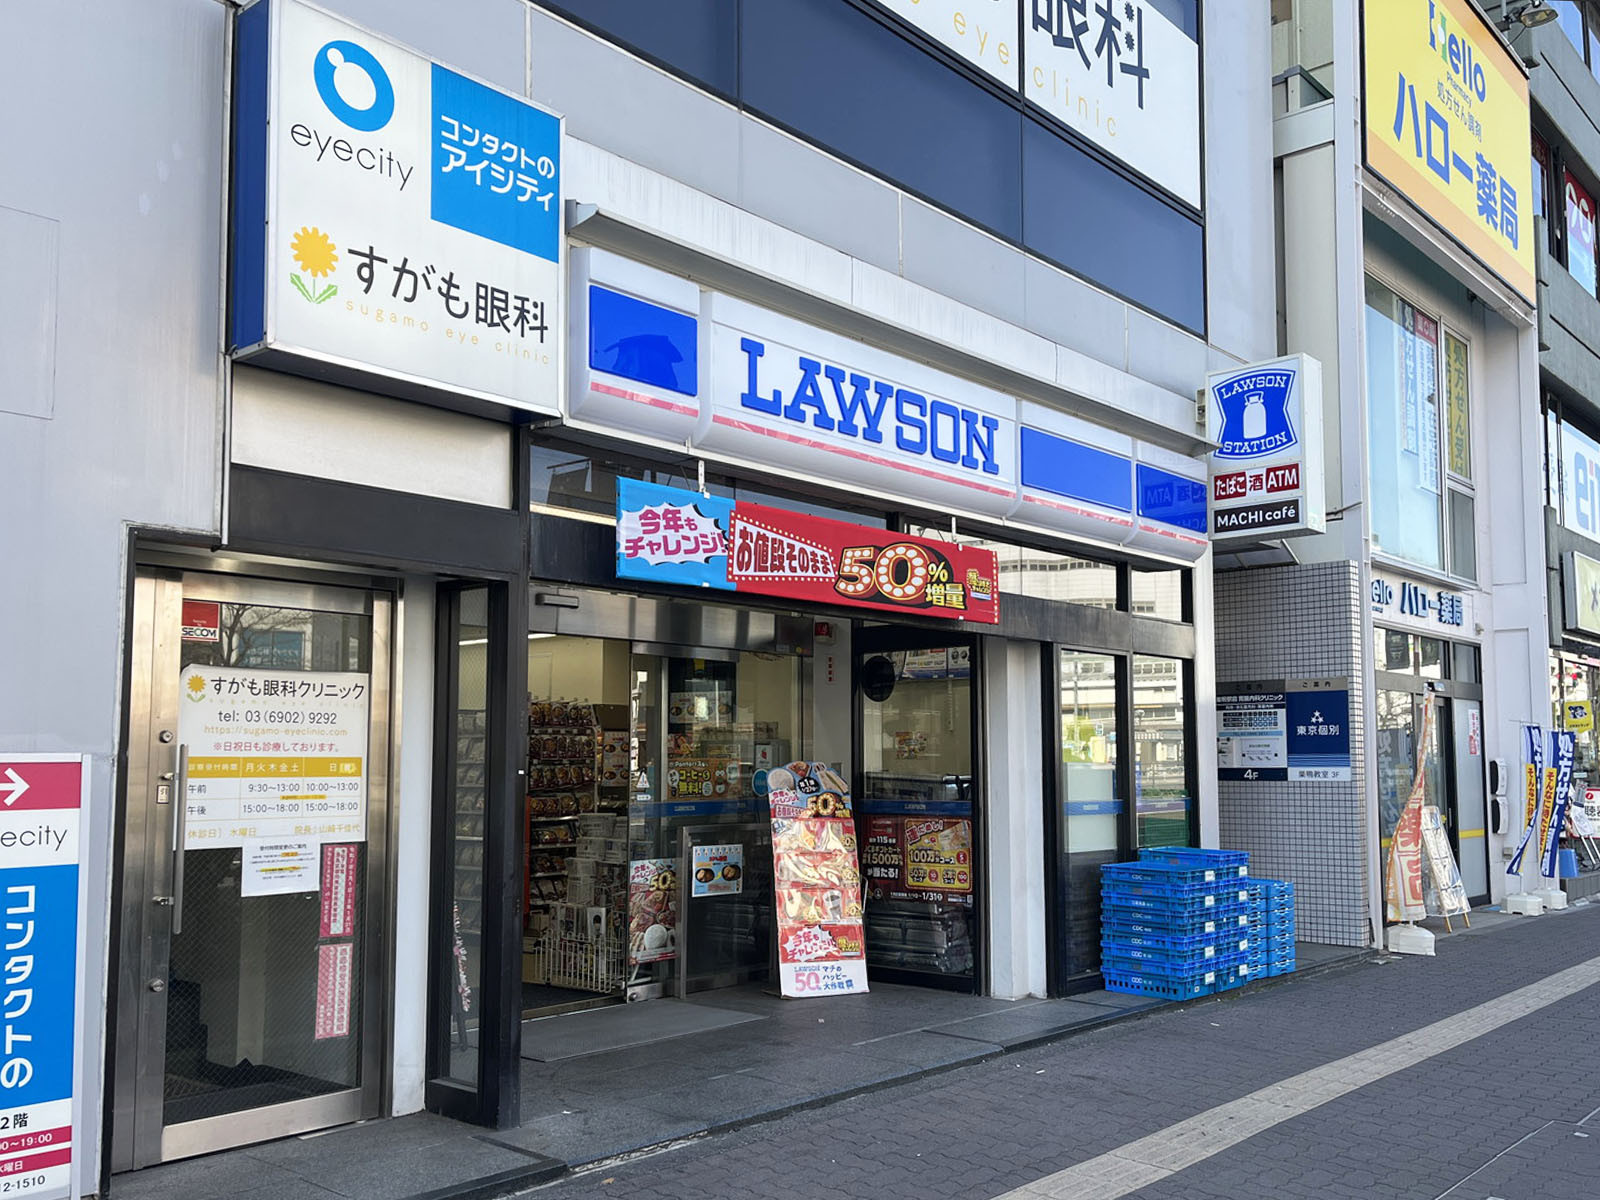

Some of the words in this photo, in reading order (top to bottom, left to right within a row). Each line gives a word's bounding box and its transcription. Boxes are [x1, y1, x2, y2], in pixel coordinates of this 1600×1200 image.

[1428, 0, 1487, 103] Hello
[954, 12, 1010, 65] eye
[1033, 66, 1117, 137] clinic
[290, 123, 414, 191] eyecity
[440, 115, 556, 180] コンタクトの
[1393, 71, 1519, 250] ハロー薬局
[441, 143, 555, 212] アイシティ
[347, 245, 549, 344] すがも眼科
[346, 300, 429, 333] sugamo
[445, 327, 480, 346] eye
[494, 339, 550, 366] clinic
[1221, 375, 1288, 400] LAWSON
[740, 336, 1000, 475] LAWSON
[1222, 431, 1288, 453] STATION
[1215, 476, 1246, 496] たばこ
[1249, 474, 1264, 491] 酒
[1266, 467, 1298, 489] ATM
[638, 508, 698, 535] 今年も
[1217, 510, 1263, 528] MACHI
[1264, 505, 1296, 521] café
[737, 525, 832, 575] お値段そのまま
[925, 583, 966, 609] 増量
[1400, 581, 1464, 627] ハロー薬局
[182, 627, 217, 638] SECOM
[210, 676, 366, 700] すがも眼科クリニック
[218, 710, 239, 723] tel:
[1296, 724, 1340, 737] 東京個別
[245, 762, 300, 773] 月火木金土
[1243, 769, 1259, 780] 4F
[188, 784, 207, 794] 午前
[187, 806, 207, 816] 午後
[1, 885, 36, 1089] コンタクトの
[2, 1175, 46, 1192] 2-1510
